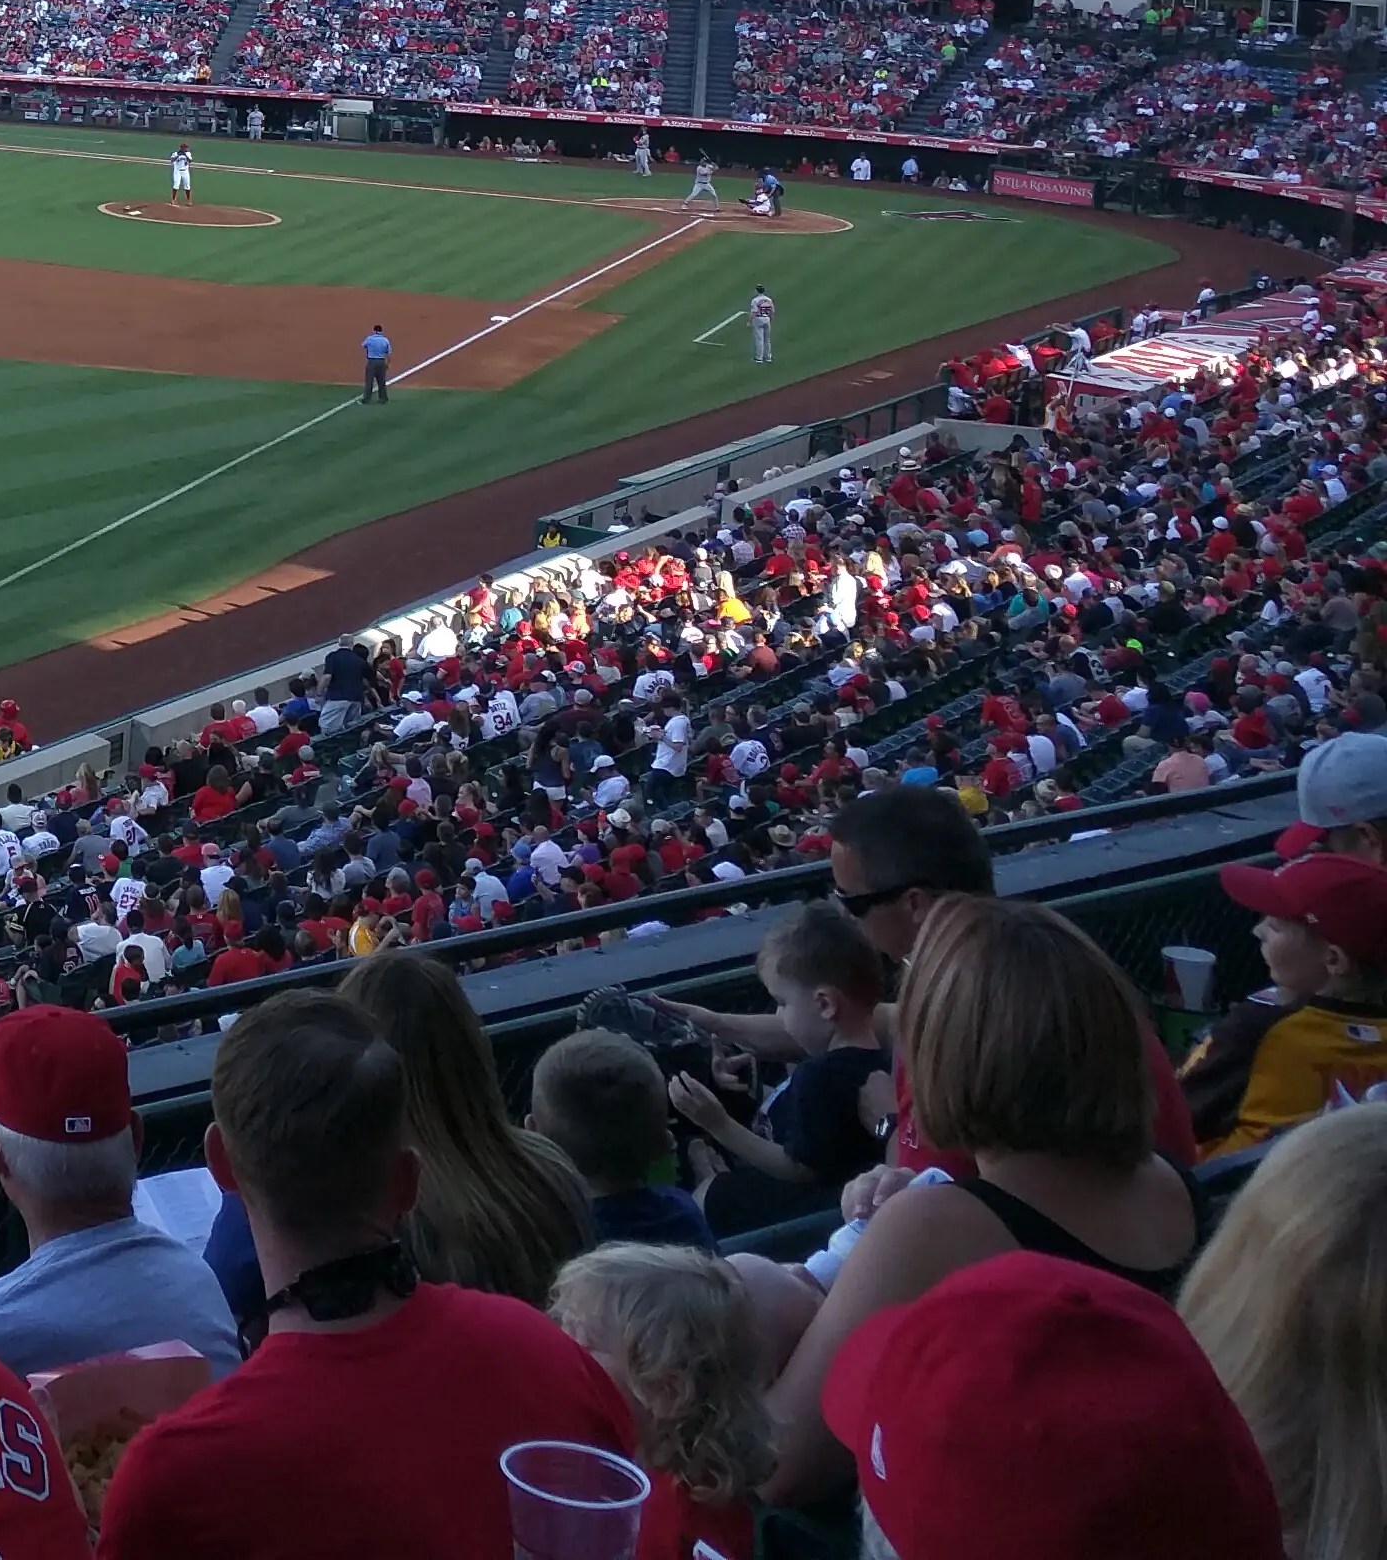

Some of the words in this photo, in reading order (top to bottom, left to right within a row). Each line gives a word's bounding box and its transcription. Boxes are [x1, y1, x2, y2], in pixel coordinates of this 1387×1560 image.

[993, 175, 1028, 189] STELLA
[492, 712, 513, 731] 34
[119, 894, 140, 909] 27
